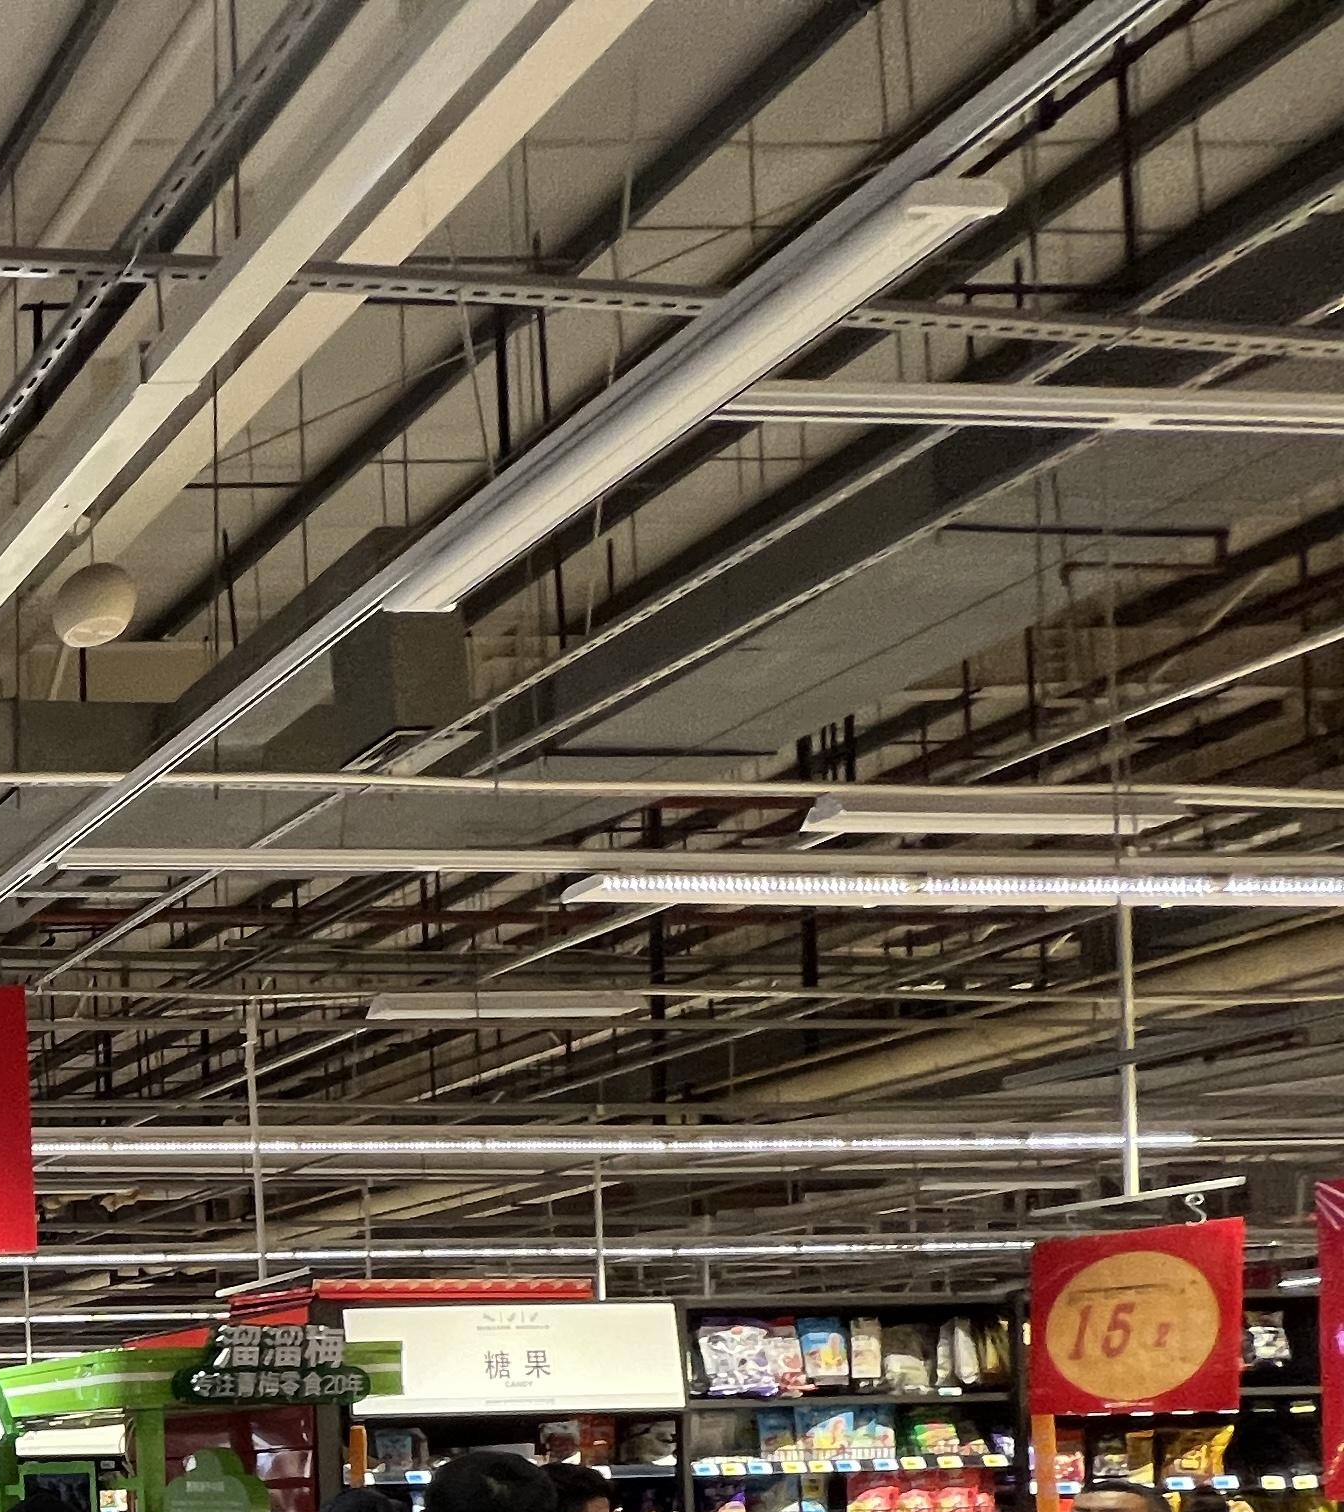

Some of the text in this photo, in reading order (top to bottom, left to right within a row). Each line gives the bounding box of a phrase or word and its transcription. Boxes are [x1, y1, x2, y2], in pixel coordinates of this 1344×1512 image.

[213, 1325, 344, 1368] 溜溜梅
[484, 1350, 551, 1379] 糖果
